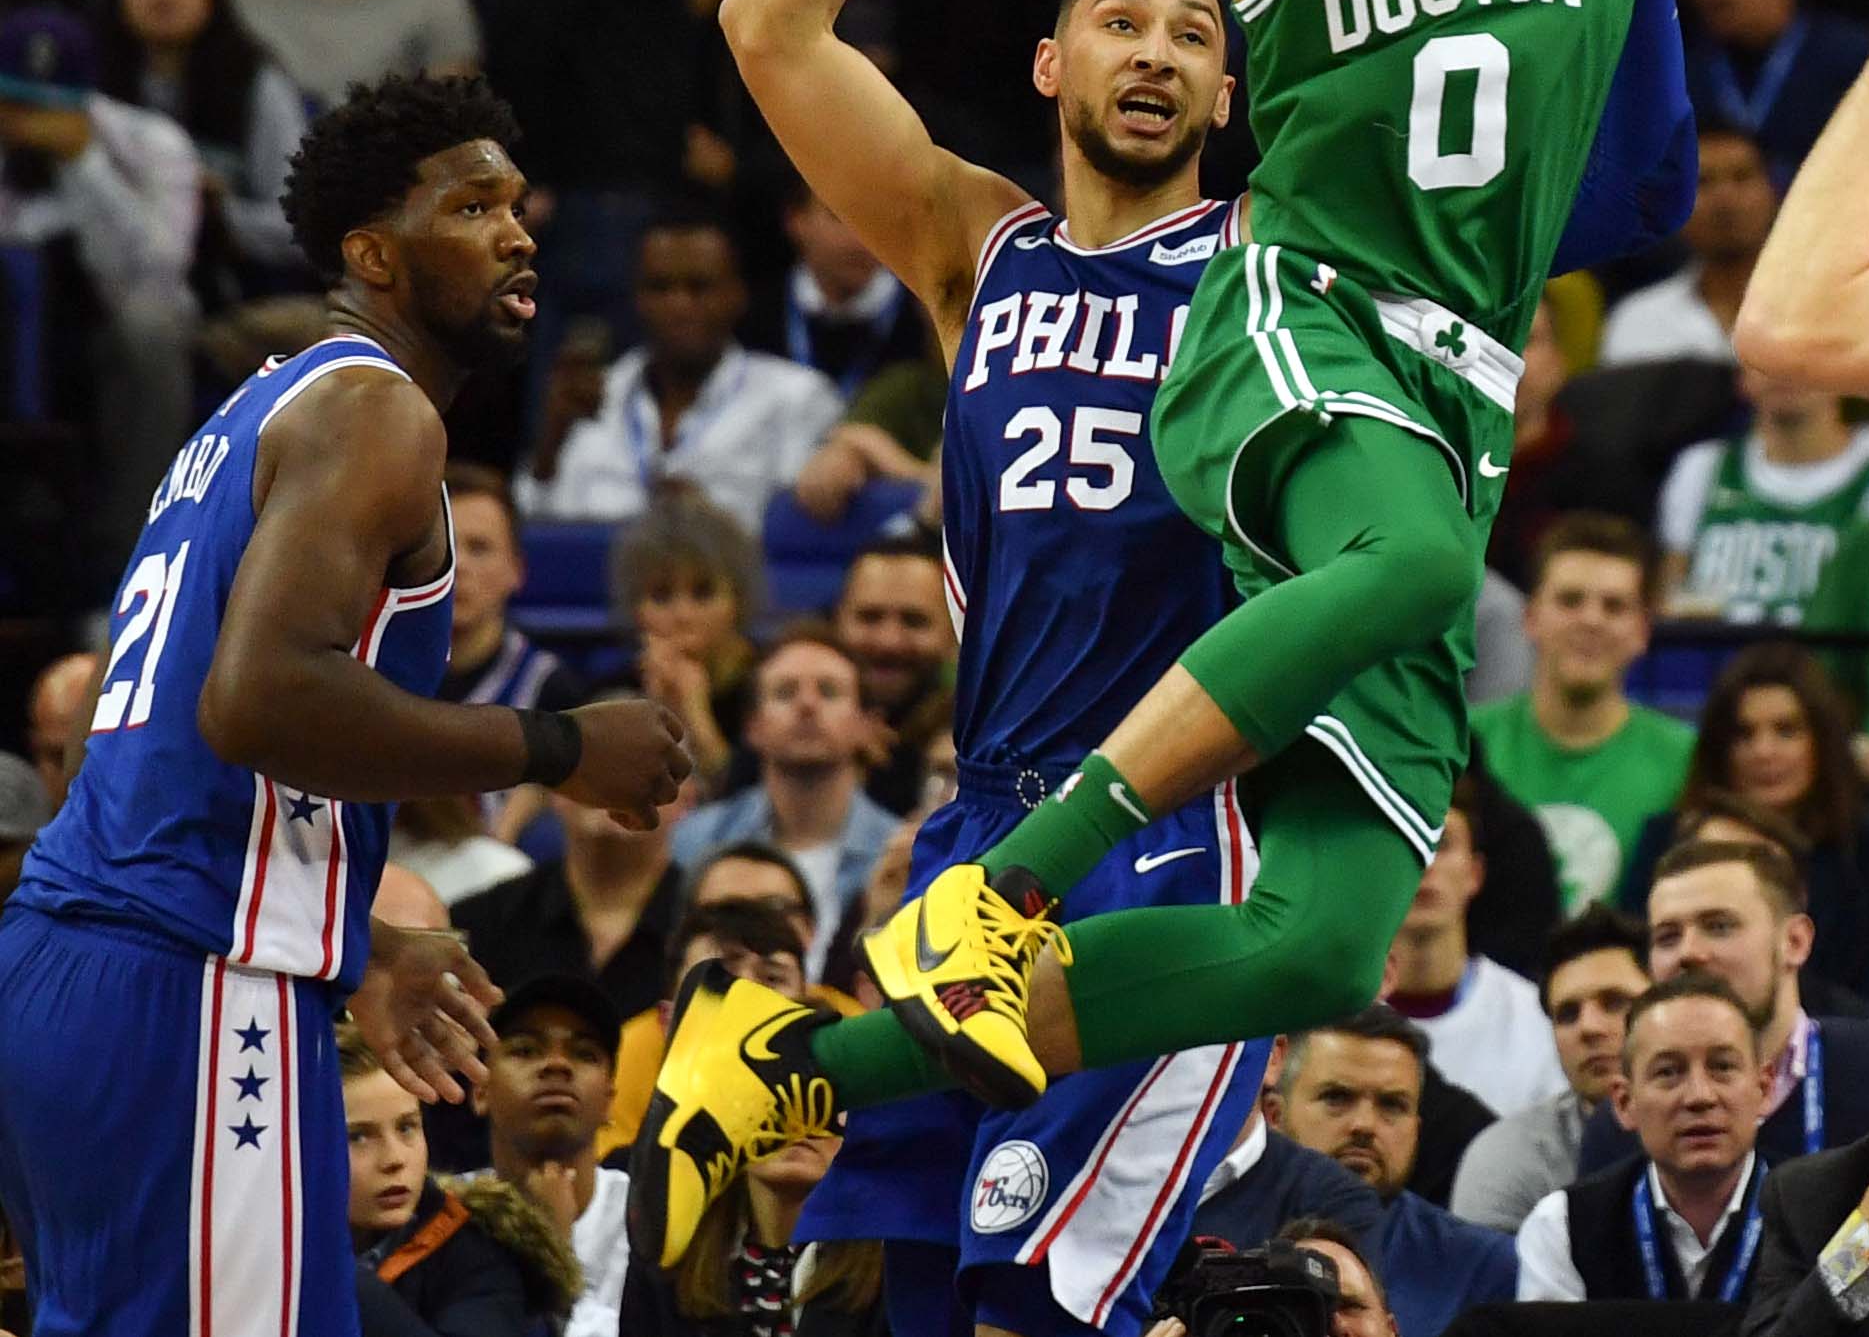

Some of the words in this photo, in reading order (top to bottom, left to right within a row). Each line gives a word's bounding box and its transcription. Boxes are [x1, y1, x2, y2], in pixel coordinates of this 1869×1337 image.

[1407, 31, 1510, 191] 0
[1000, 405, 1143, 513] 25
[90, 539, 191, 734] 21
[977, 1175, 1031, 1214] 76ers
